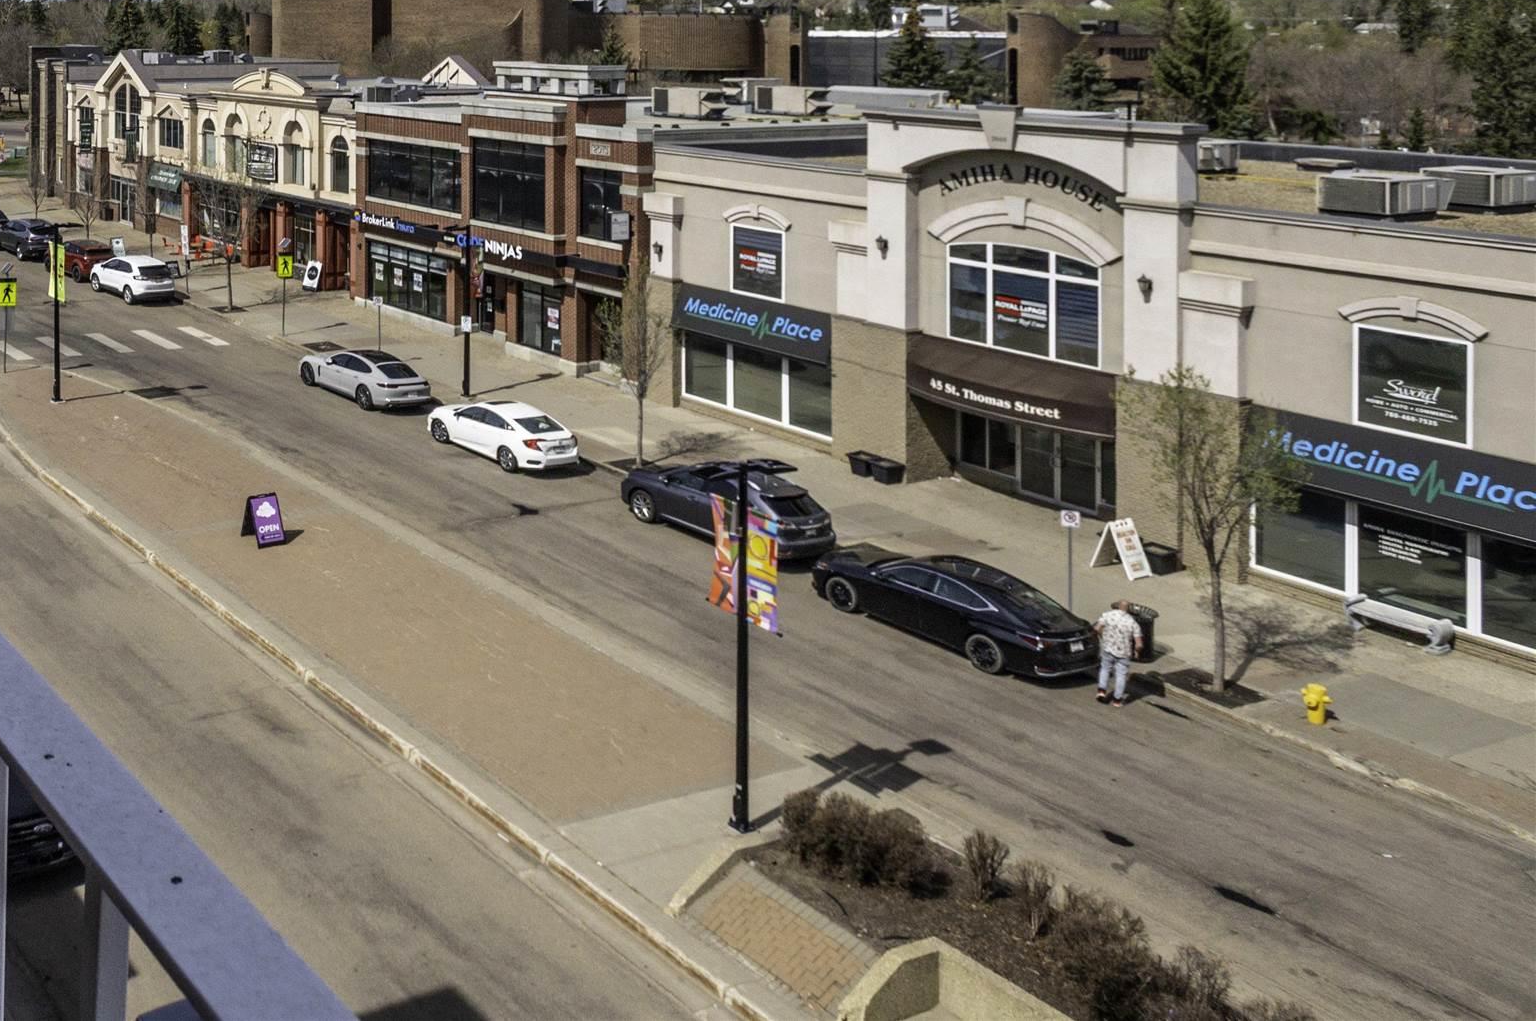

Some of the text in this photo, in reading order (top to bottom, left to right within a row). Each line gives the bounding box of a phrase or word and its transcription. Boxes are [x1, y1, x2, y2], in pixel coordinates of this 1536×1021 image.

[937, 164, 1109, 212] AMIHA HOUSE
[361, 212, 395, 229] BrokerLink
[484, 239, 523, 260] NINJAS
[994, 300, 1019, 311] ROYAL
[684, 297, 823, 342] Medicine Place
[944, 383, 961, 397] St.
[962, 388, 1012, 409] Thomas
[1014, 401, 1061, 420] Street
[1383, 378, 1441, 405] Sword
[1454, 471, 1536, 510] Plac
[258, 523, 280, 534] OPEN
